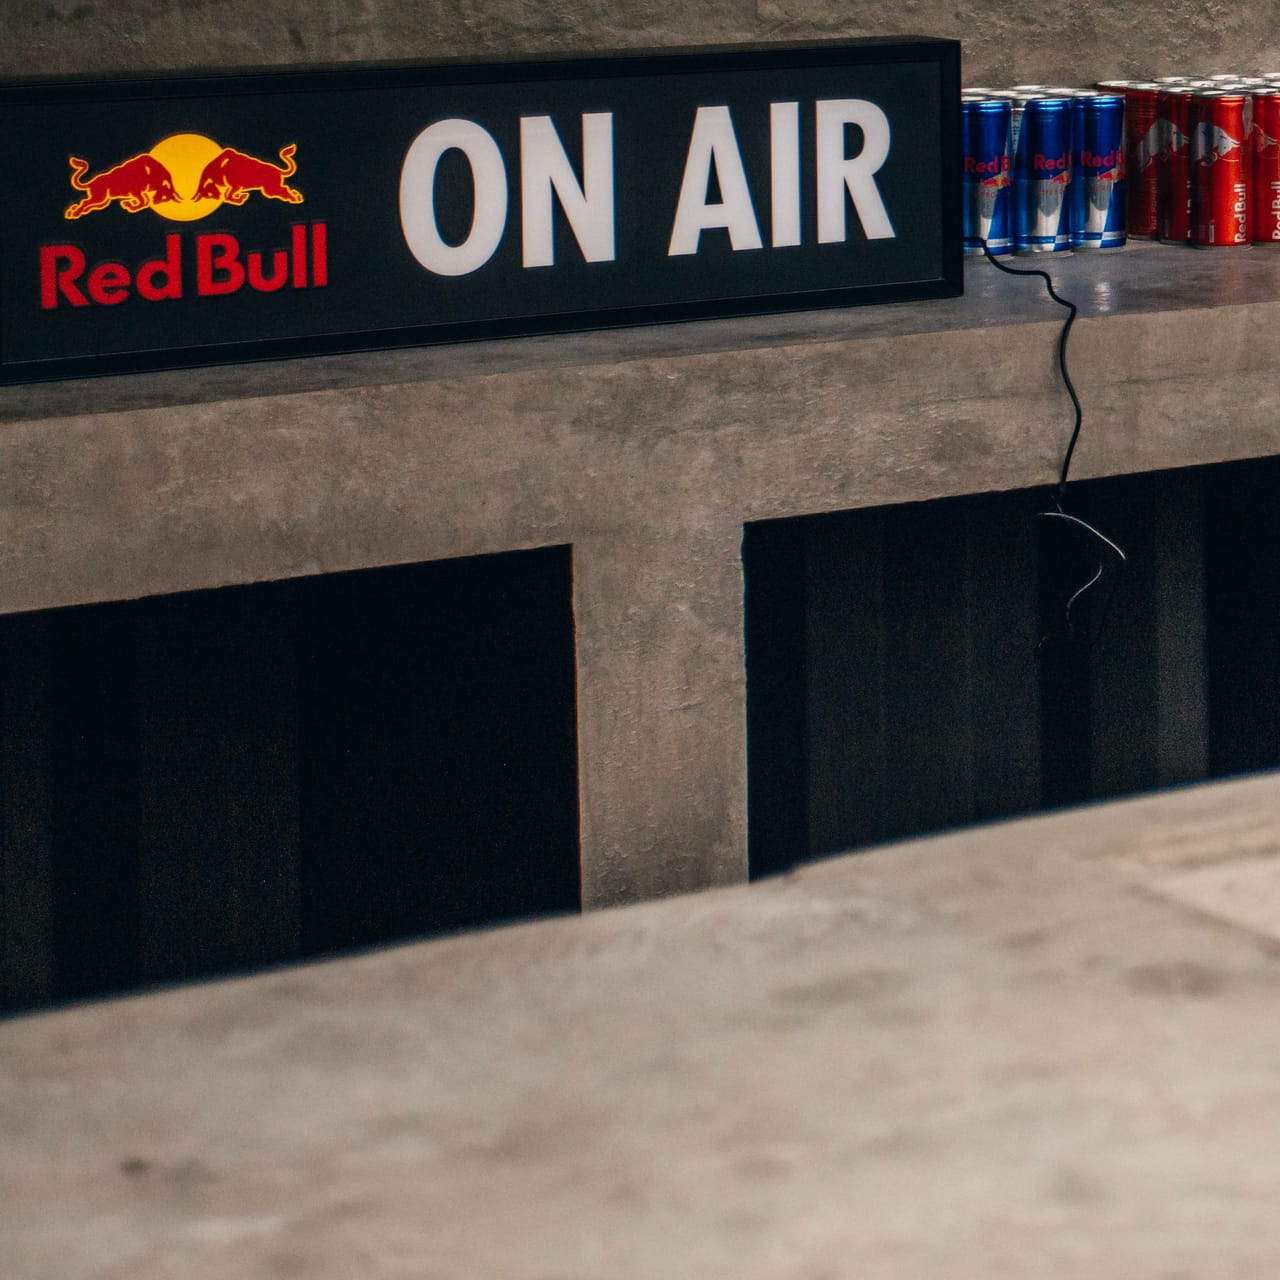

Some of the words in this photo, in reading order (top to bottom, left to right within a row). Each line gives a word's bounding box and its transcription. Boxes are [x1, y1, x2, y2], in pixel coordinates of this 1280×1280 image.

[964, 155, 999, 173] Red
[1034, 153, 1065, 170] Red
[1081, 150, 1116, 168] Red
[400, 111, 617, 277] ON
[668, 98, 896, 257] AIR
[1234, 184, 1246, 212] Bull
[1234, 214, 1246, 242] Red
[40, 233, 183, 309] Red
[196, 223, 328, 297] Bull
